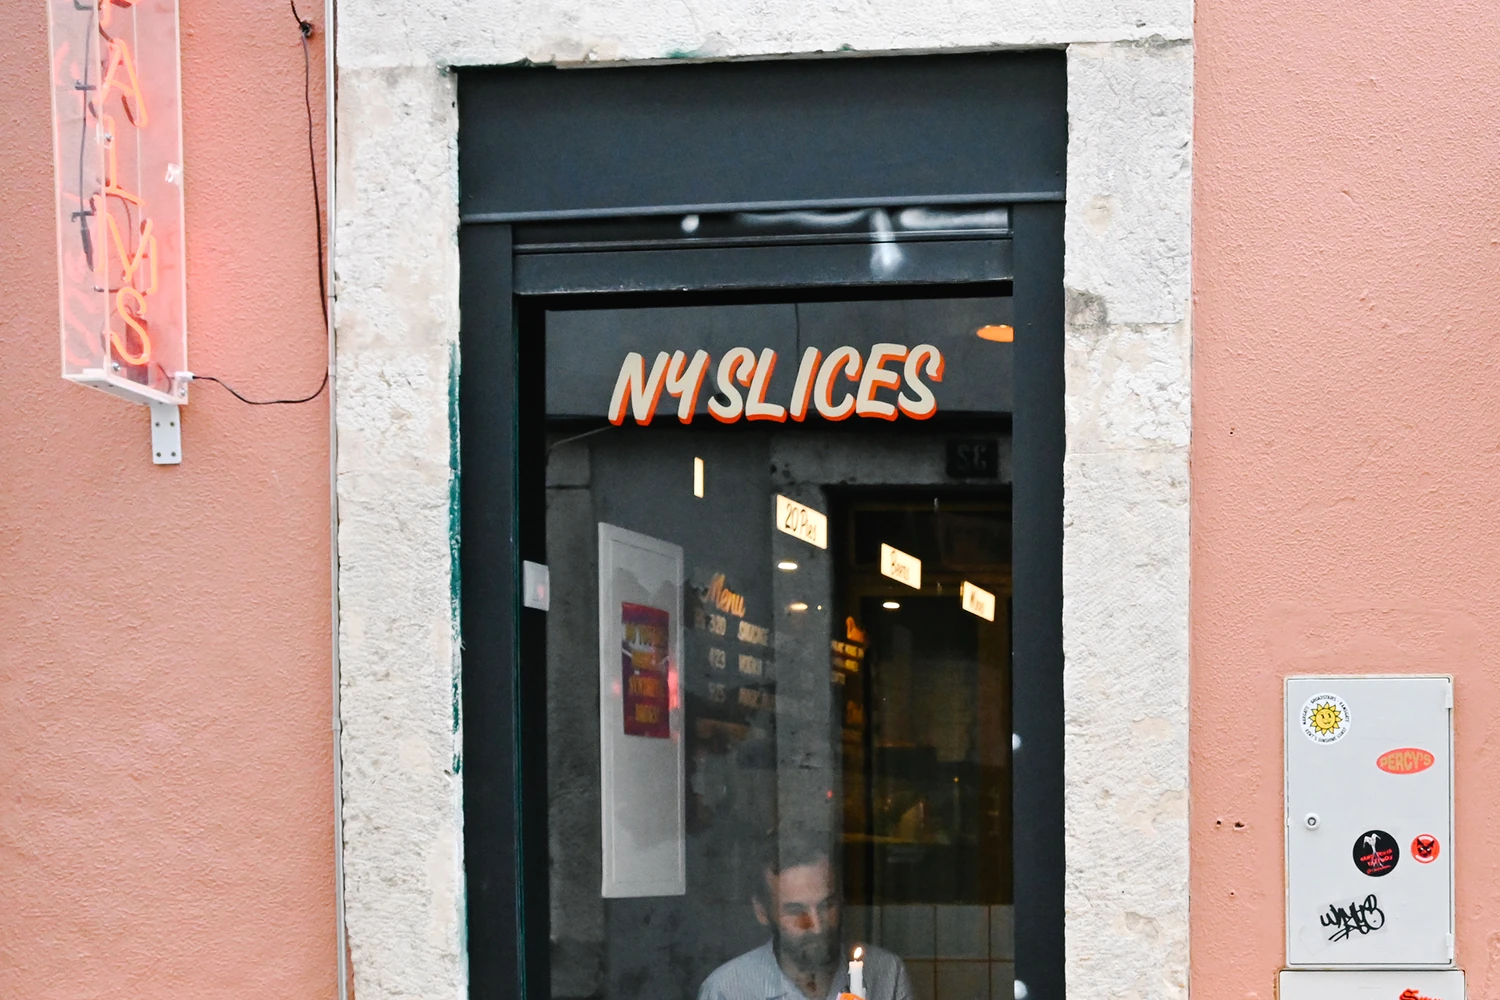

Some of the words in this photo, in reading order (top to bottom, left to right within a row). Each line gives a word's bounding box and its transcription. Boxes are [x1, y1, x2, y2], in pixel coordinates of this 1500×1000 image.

[92, 0, 157, 366] ALMS
[607, 349, 710, 427] NY
[707, 342, 945, 425] SLICES
[1380, 751, 1433, 772] PERCY'S
